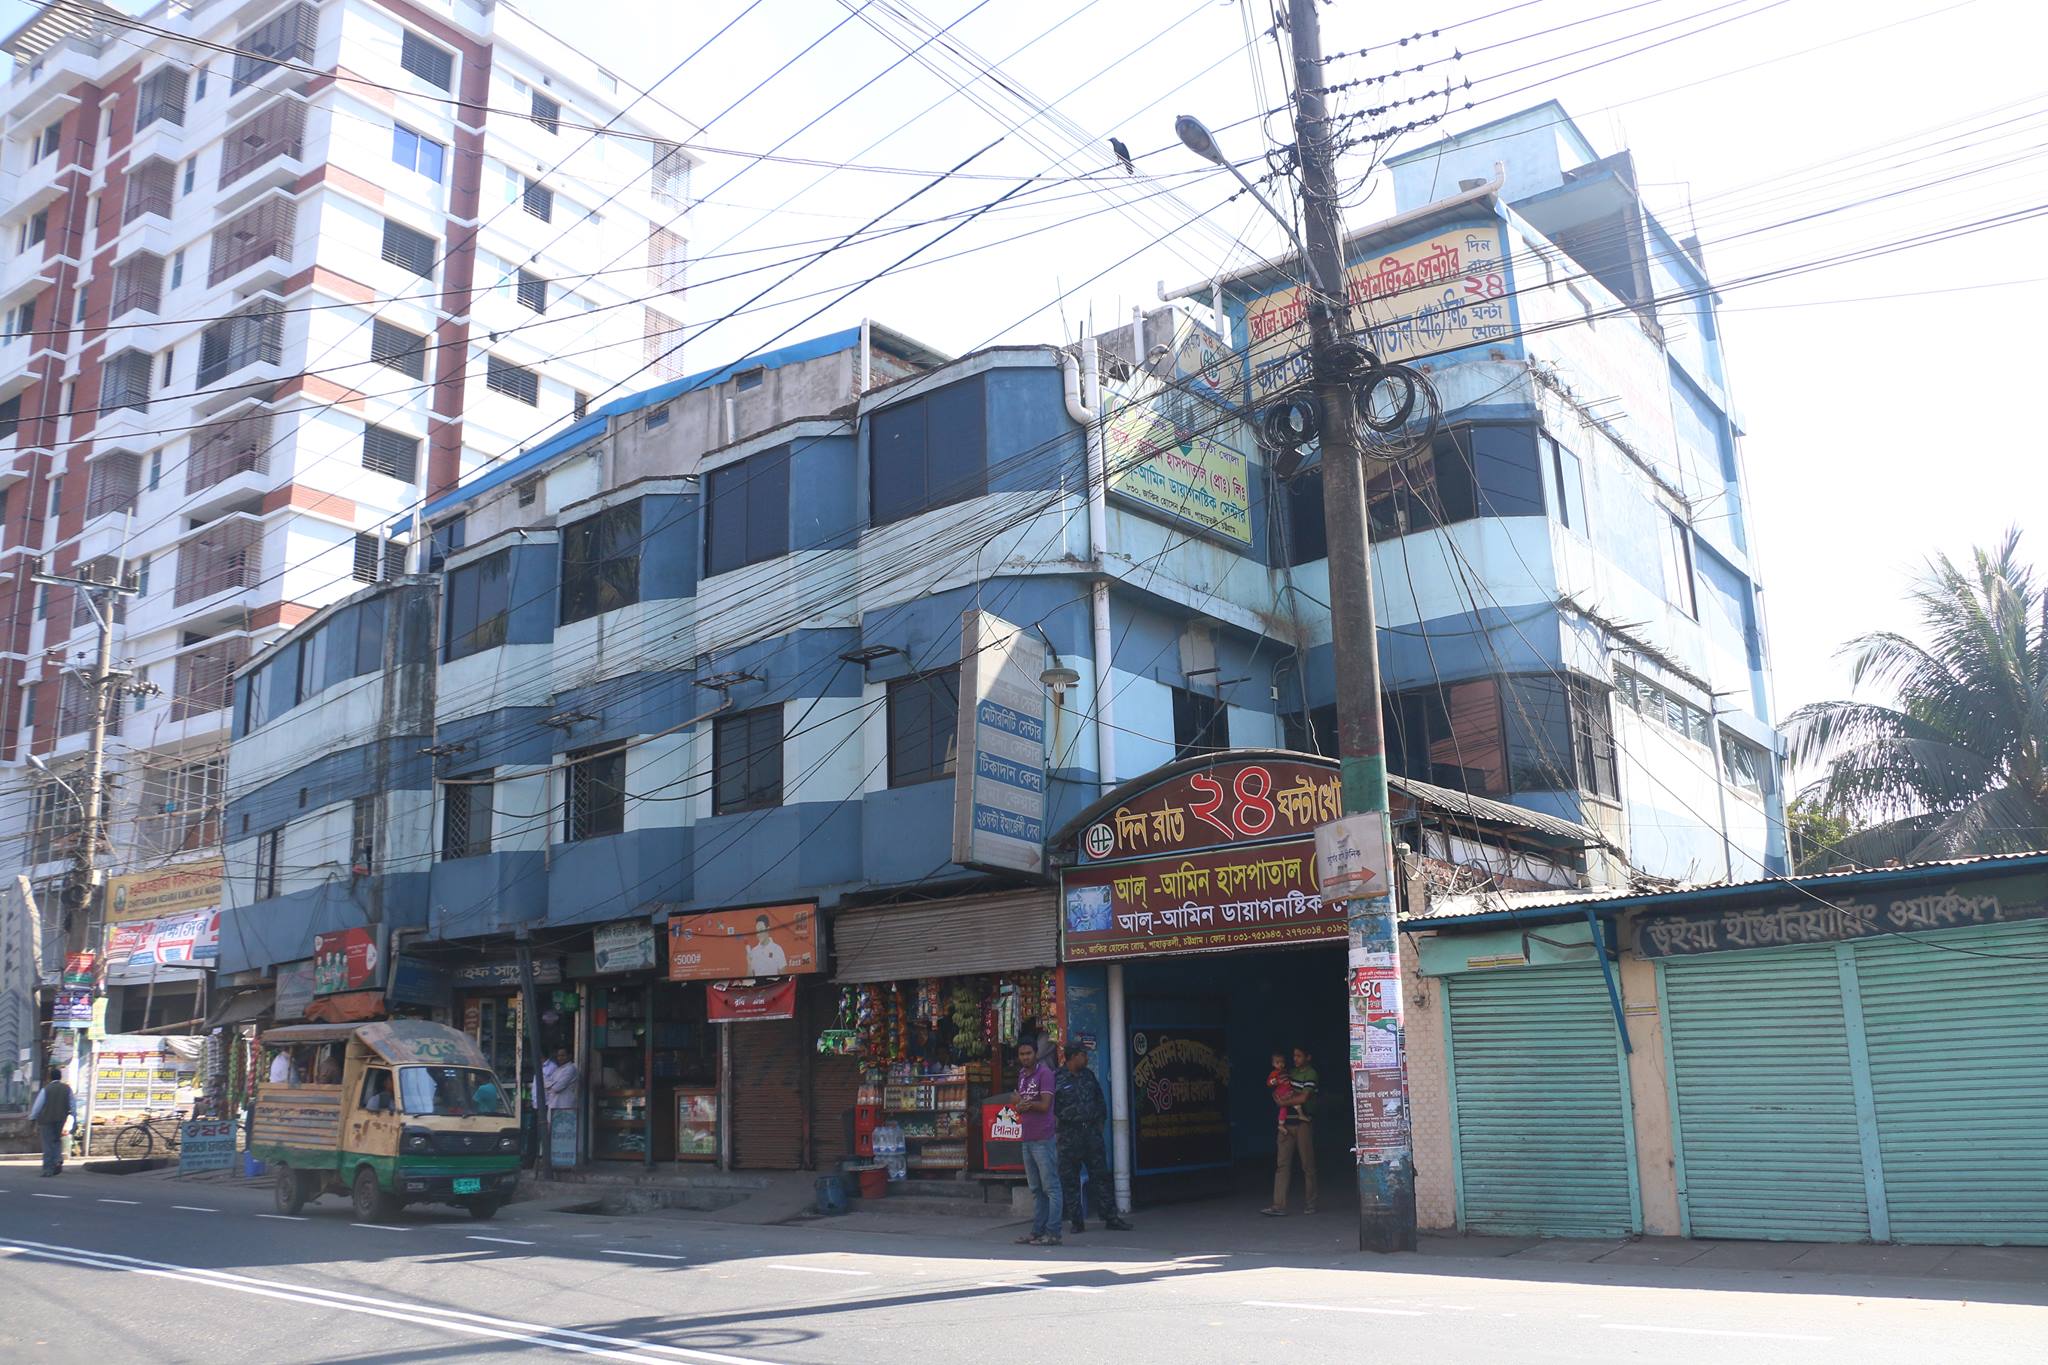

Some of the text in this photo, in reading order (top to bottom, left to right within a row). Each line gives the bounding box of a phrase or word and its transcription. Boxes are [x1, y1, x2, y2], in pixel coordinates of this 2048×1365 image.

[1465, 234, 1491, 252] দিন
[1417, 243, 1461, 287] সেন্টার
[1467, 259, 1494, 274] রাত
[1464, 273, 1505, 303] ২৪
[1472, 323, 1505, 340] খোলা
[1166, 453, 1206, 486] হাসপাতাল
[1220, 500, 1246, 523] সেন্টার
[980, 704, 1042, 740] মেটারনিটি সেন্টার
[979, 752, 1041, 792] টিকাদান কেন্দ্র
[1115, 766, 1342, 850] দিন রাত ২৪ ঘন্টা খো
[1215, 857, 1302, 897] হাসপাতাল
